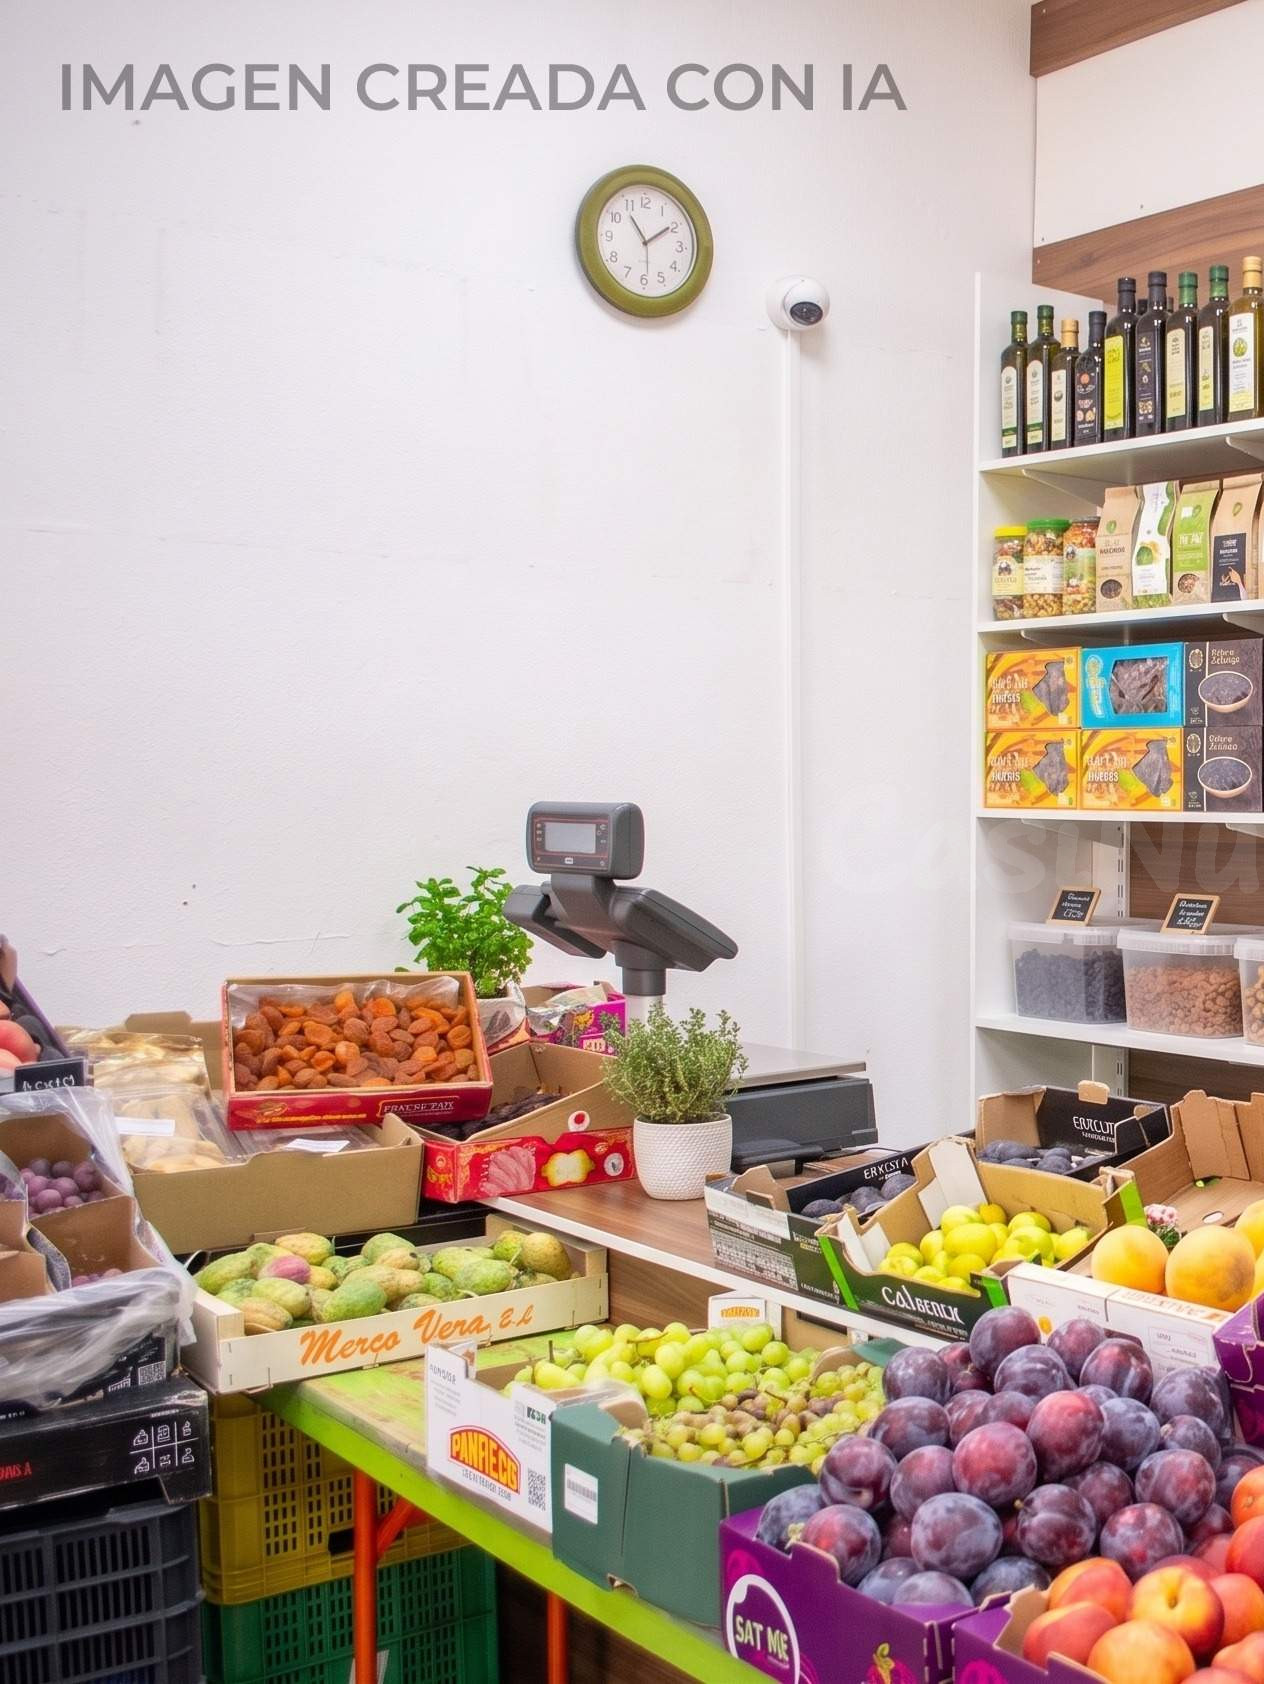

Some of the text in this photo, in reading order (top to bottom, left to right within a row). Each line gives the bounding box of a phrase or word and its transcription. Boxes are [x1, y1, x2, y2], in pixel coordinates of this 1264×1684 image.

[412, 1308, 491, 1345] Vera
[735, 1614, 790, 1663] SAT ME
